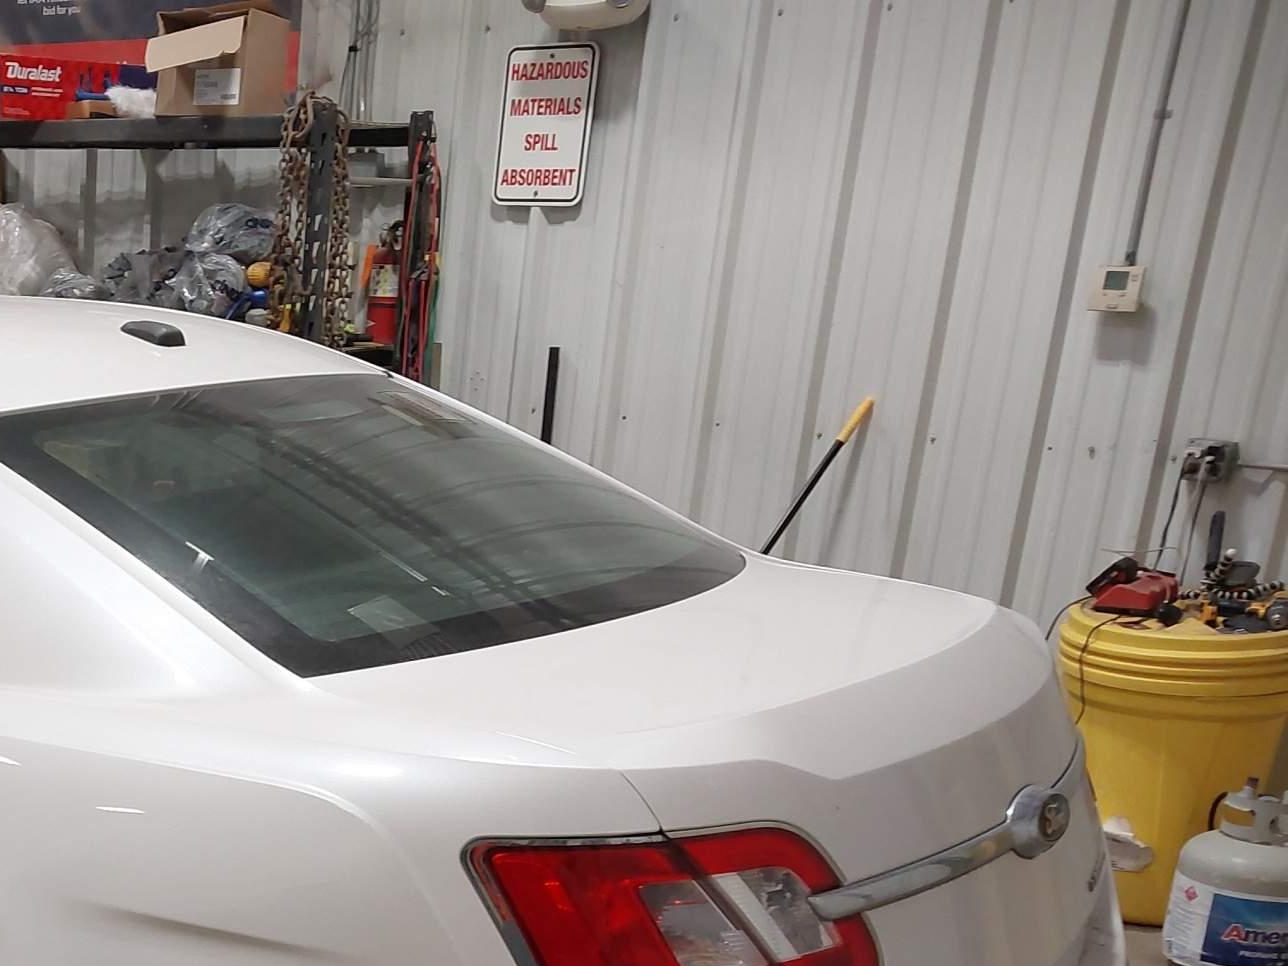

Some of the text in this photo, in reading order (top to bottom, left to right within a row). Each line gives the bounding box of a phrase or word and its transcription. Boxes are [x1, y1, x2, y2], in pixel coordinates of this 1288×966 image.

[5, 61, 62, 82] Duralast
[511, 60, 589, 81] HAZARDOUS
[510, 97, 582, 116] MATERIALS
[524, 133, 558, 151] SPILL
[500, 168, 576, 186] ABSORBENT
